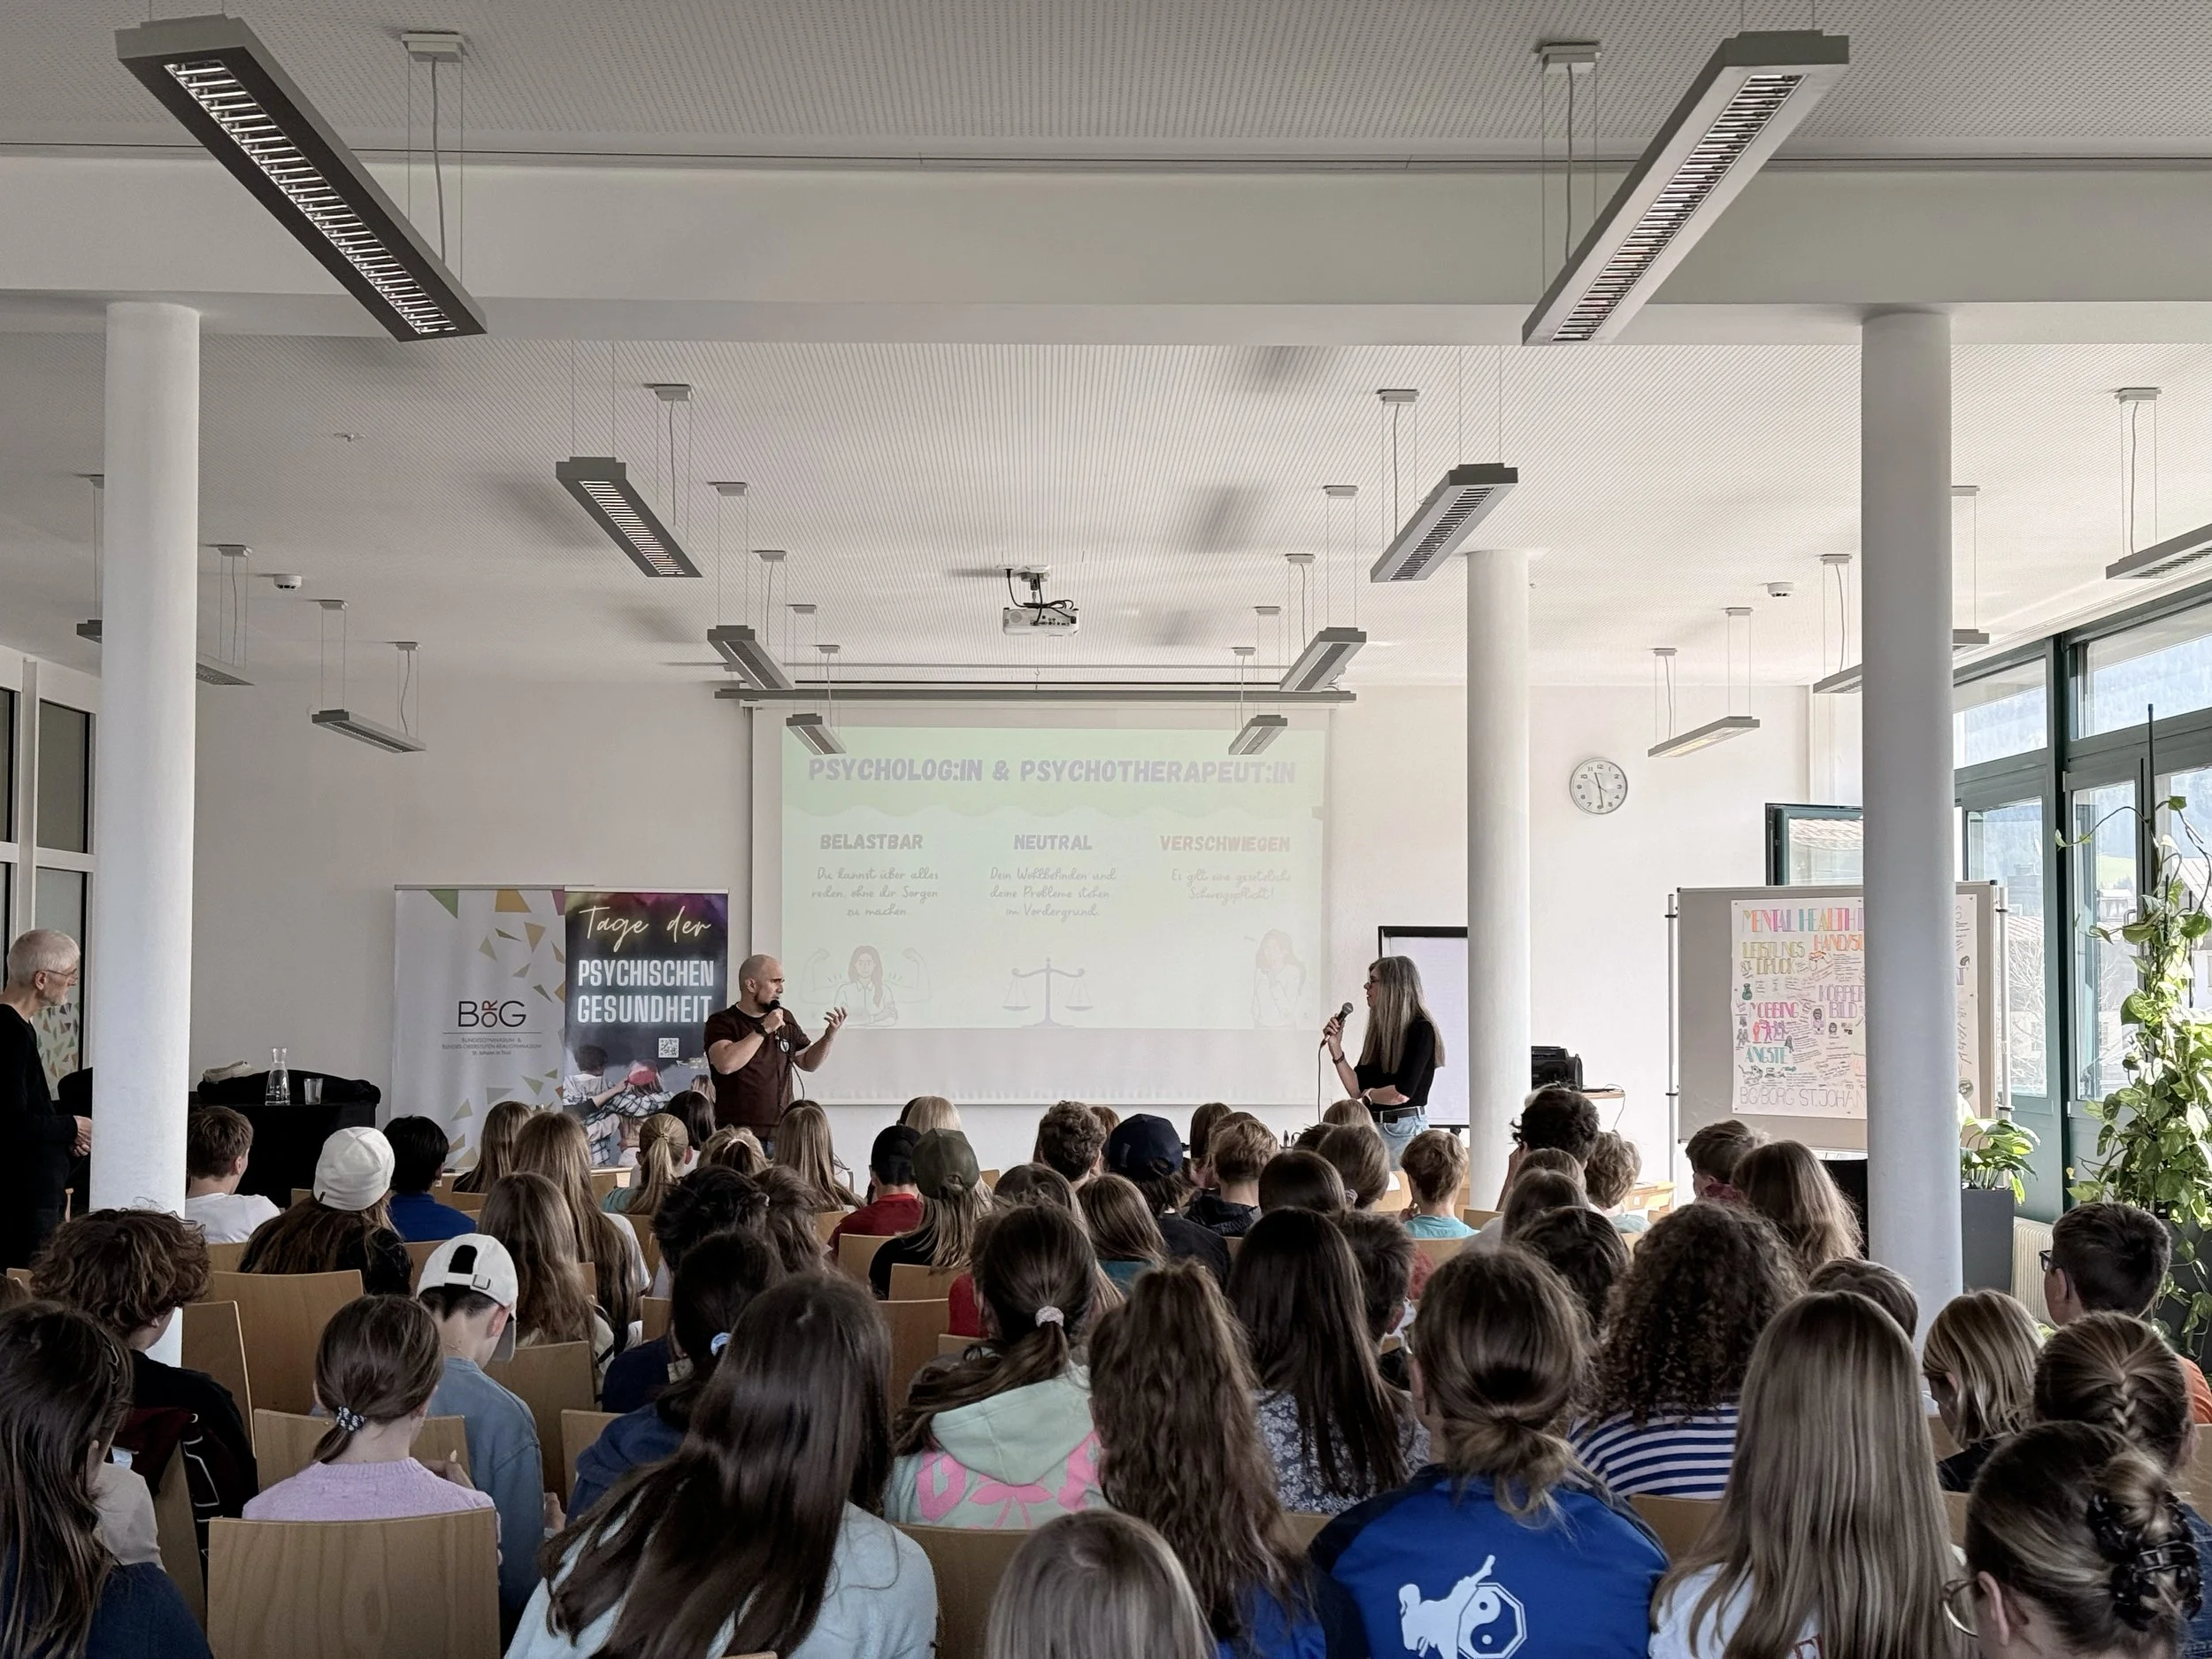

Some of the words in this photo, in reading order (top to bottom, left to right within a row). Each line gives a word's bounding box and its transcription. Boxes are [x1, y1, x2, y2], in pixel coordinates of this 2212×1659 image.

[993, 760, 1010, 781] &
[820, 833, 923, 850] BELASTBAR
[1014, 834, 1092, 850] NEUTRAL
[1160, 835, 1290, 852] VERSCHWIEGEN
[817, 866, 833, 880] Du
[837, 866, 876, 880] kannst
[879, 867, 905, 880] über
[910, 866, 939, 880] alles
[990, 866, 1011, 880] Dein
[1092, 867, 1117, 881] und
[1171, 868, 1182, 882] Es
[849, 885, 874, 898] ohne
[879, 885, 896, 898] dir
[902, 885, 939, 902] Sorgen
[989, 885, 1018, 899] deine
[1023, 885, 1073, 899] Probleme
[1078, 886, 1110, 899] stehen
[846, 908, 860, 917] zu
[1005, 907, 1019, 916] im
[579, 905, 649, 952] Tage
[666, 905, 711, 943] der
[1742, 909, 1795, 933] MENTAL
[1799, 908, 1857, 932] HEALTH
[578, 959, 714, 987] PSYCHISCHEN
[1756, 957, 1795, 975] DRUCK
[577, 995, 712, 1023] GESUNDHEIT
[1749, 1002, 1799, 1018] MOBBING
[1829, 1002, 1857, 1018] BILD
